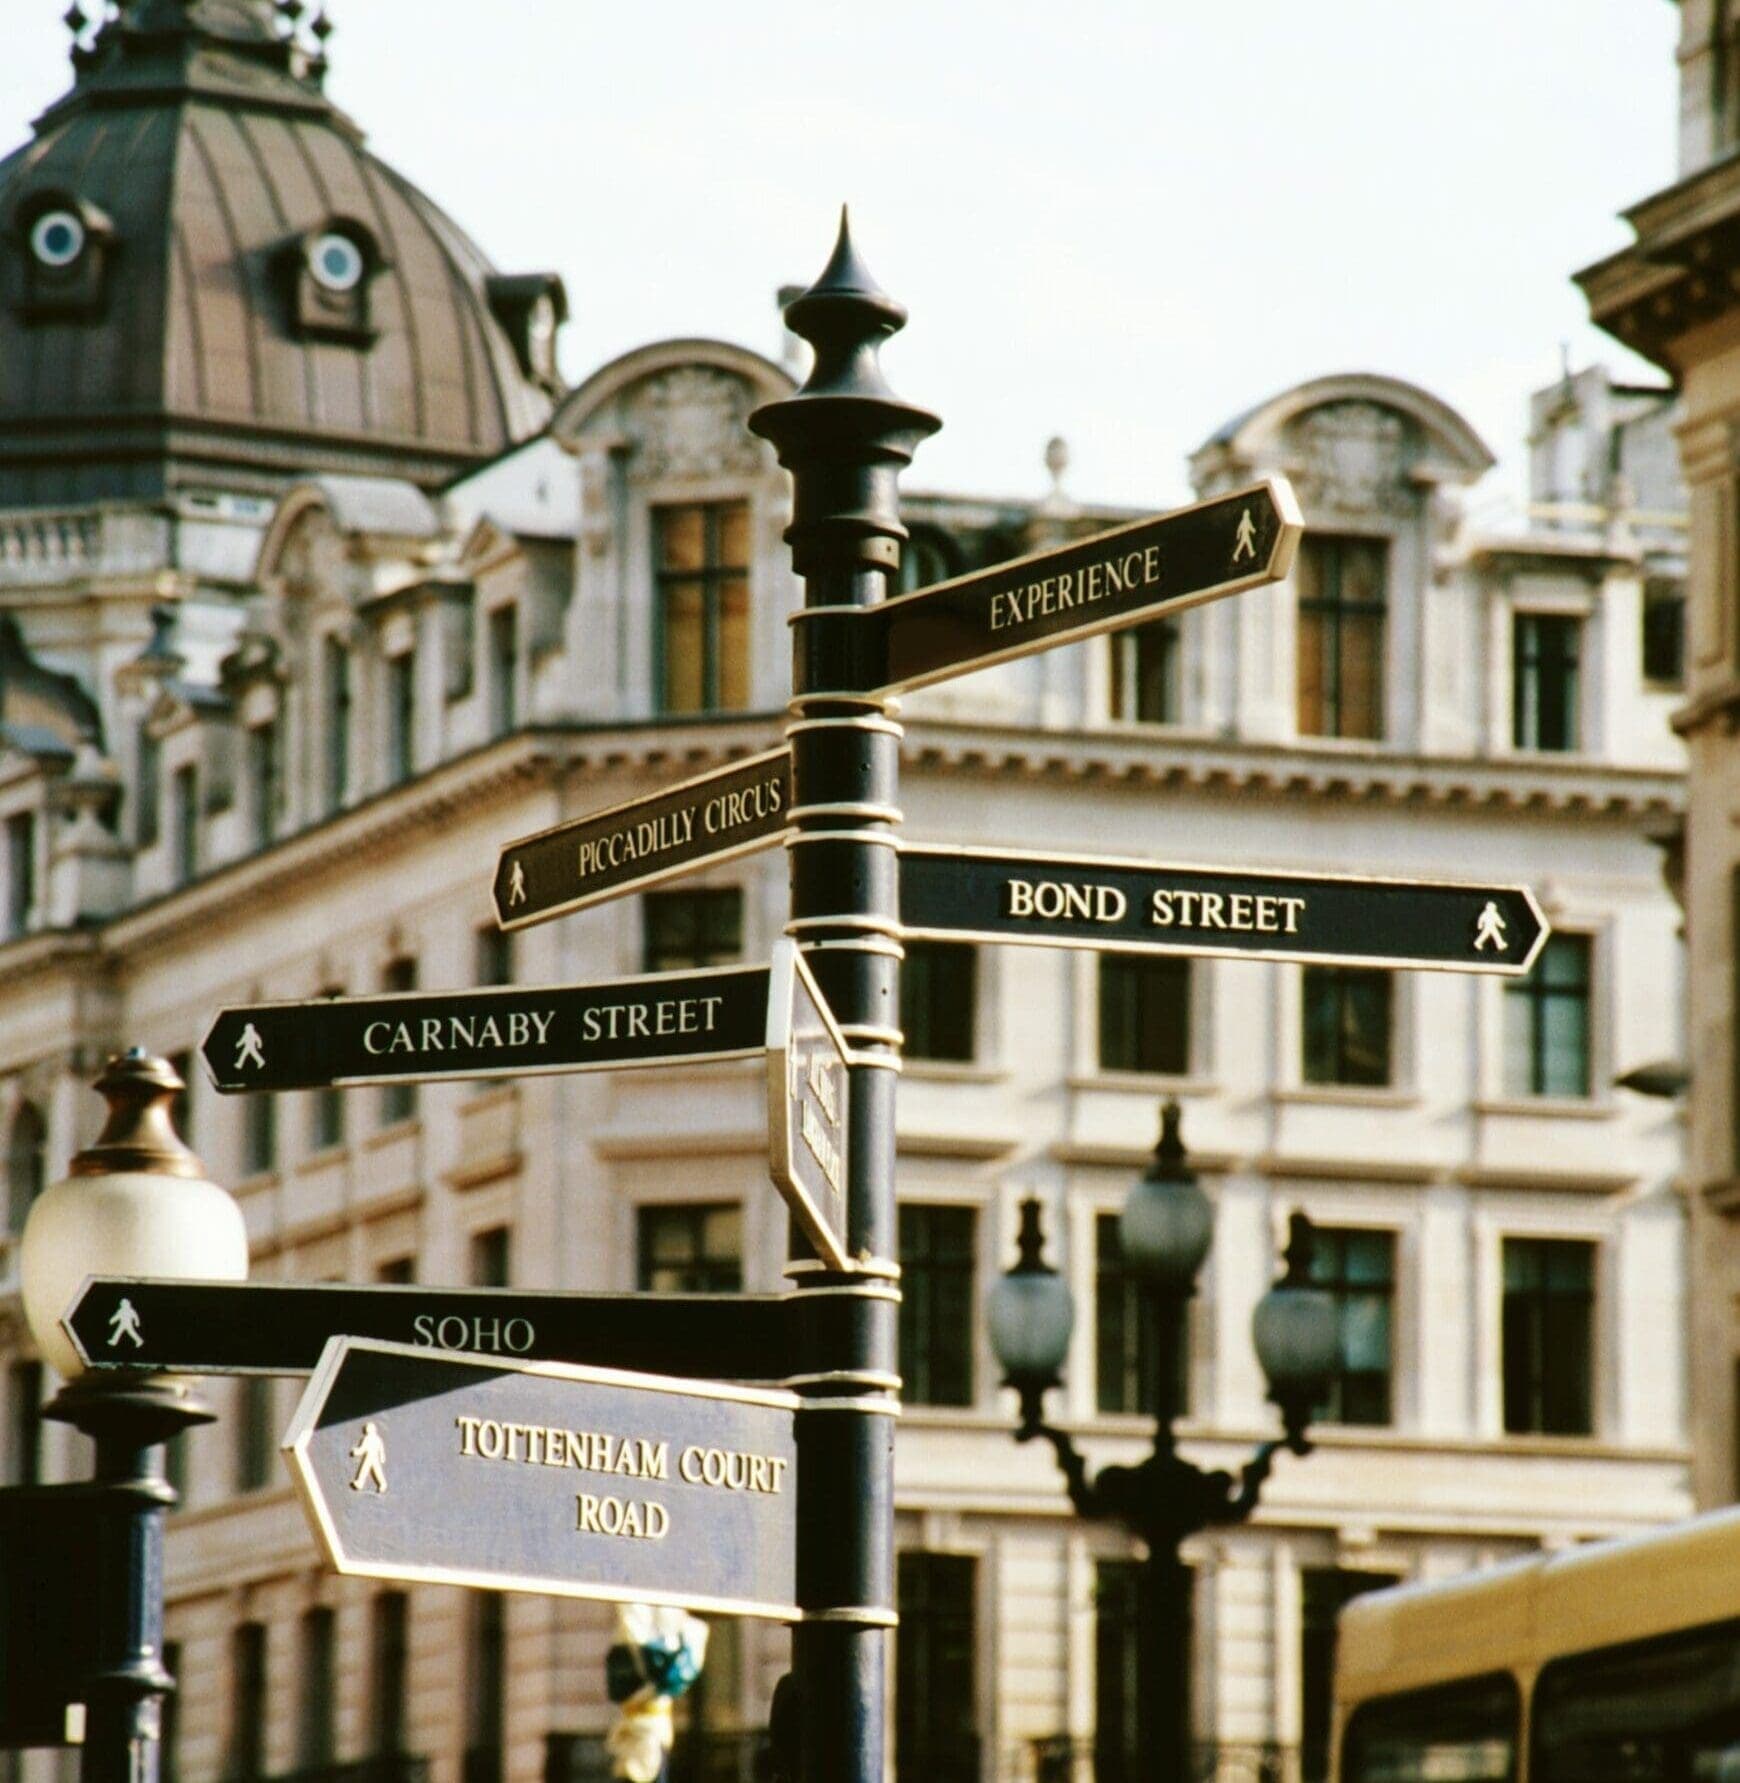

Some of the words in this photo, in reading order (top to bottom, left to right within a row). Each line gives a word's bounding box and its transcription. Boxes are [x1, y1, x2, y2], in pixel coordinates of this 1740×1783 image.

[990, 546, 1160, 630] EXPERIENCE
[579, 806, 697, 876] PICCADILLY
[704, 778, 781, 834] CIRCUS
[1008, 879, 1127, 922] BOND
[1152, 889, 1306, 932] STREET
[363, 1010, 556, 1054] CARNABY
[582, 997, 723, 1041] STREET
[413, 1315, 536, 1352] SOHO
[456, 1416, 669, 1480] TOTTENHAM
[680, 1446, 787, 1493] COURT
[576, 1494, 670, 1539] ROAD
